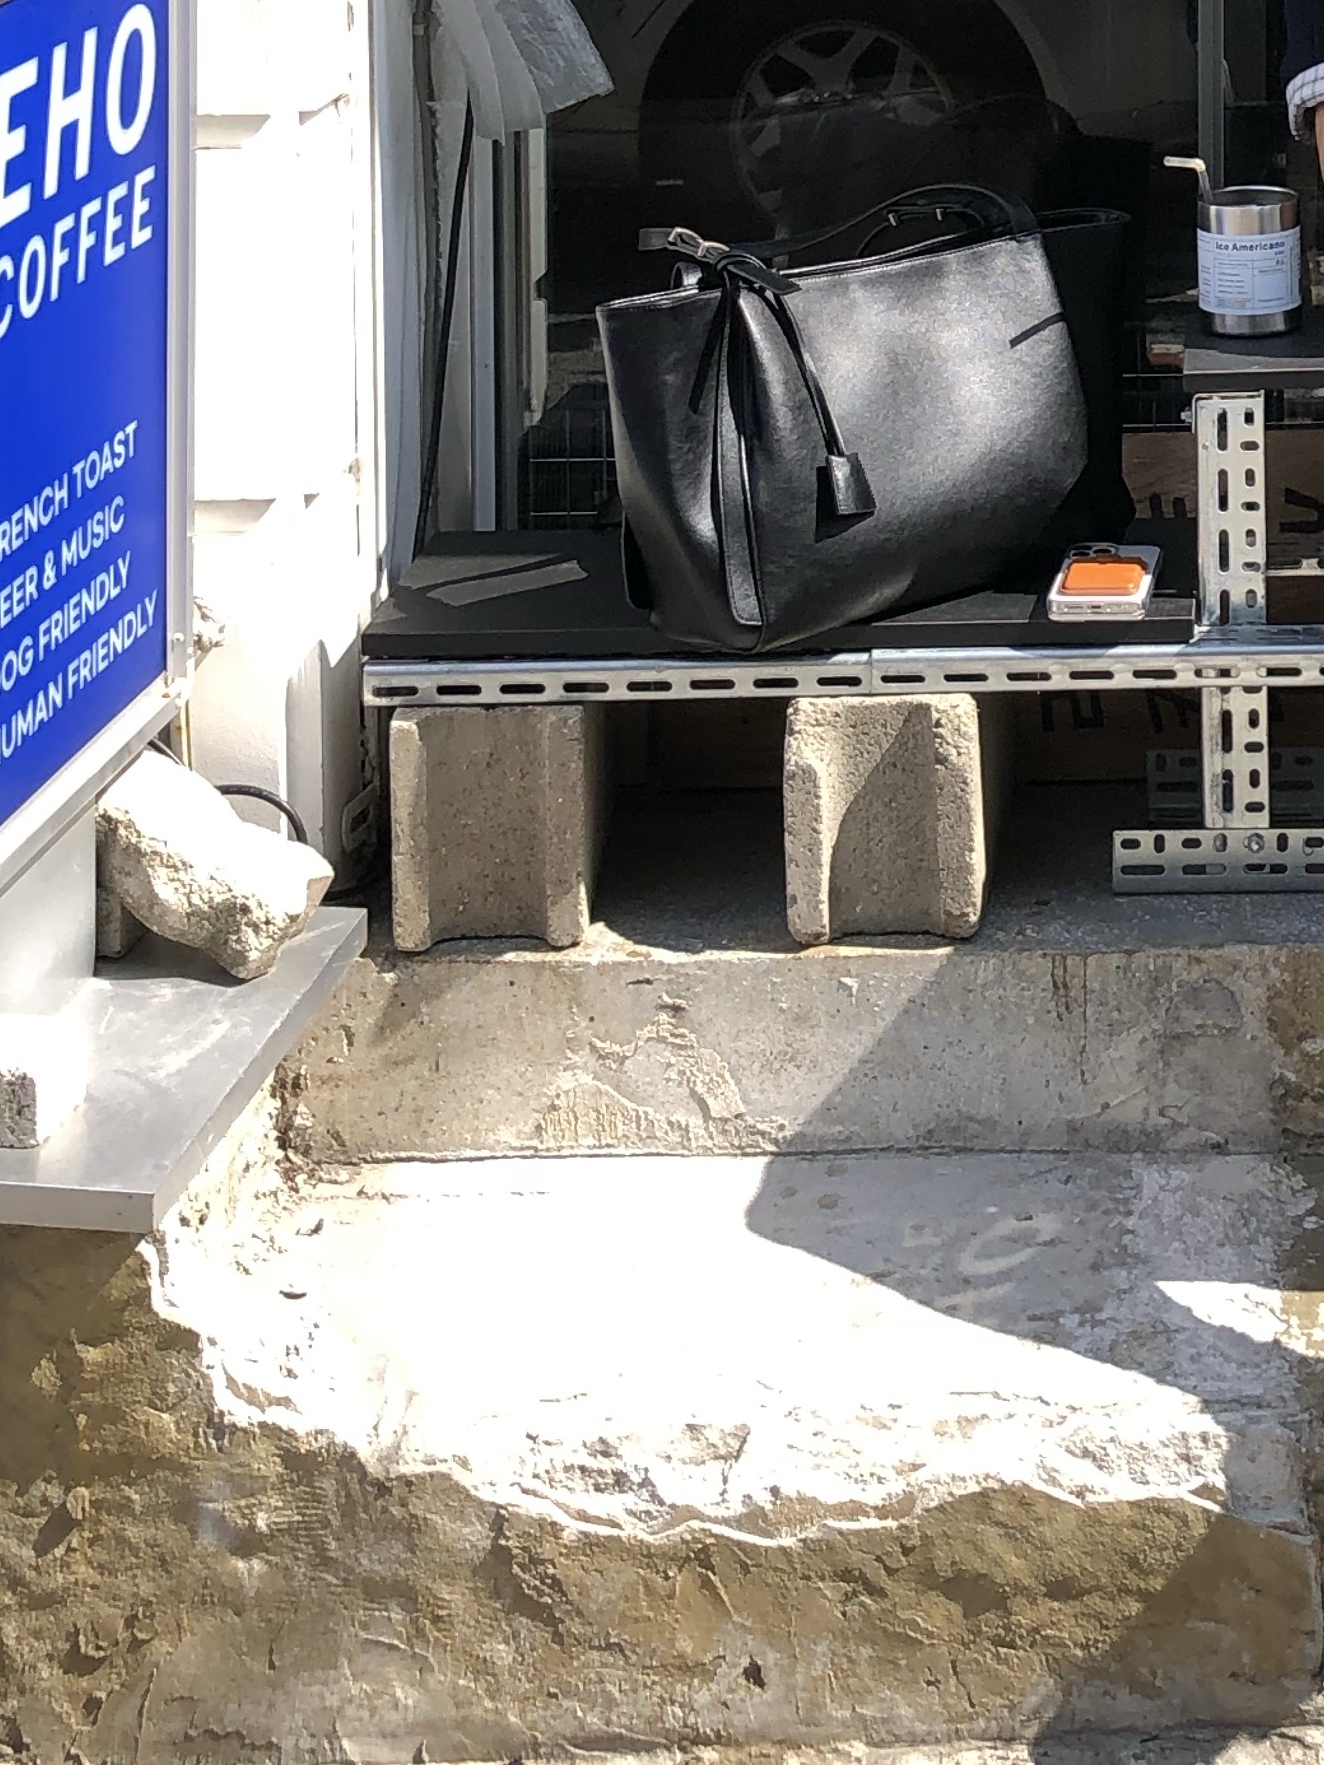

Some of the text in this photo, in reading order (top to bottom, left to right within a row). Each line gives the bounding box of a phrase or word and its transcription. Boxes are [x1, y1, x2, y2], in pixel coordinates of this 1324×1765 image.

[0, 3, 156, 227] EHO
[1215, 241, 1229, 252] Ice
[0, 419, 139, 563] RENCH TOAST
[0, 495, 125, 630] EER & MUSIC
[0, 588, 158, 763] UMAN FRIENDLY
[1, 549, 131, 691] OG FRIENDLY
